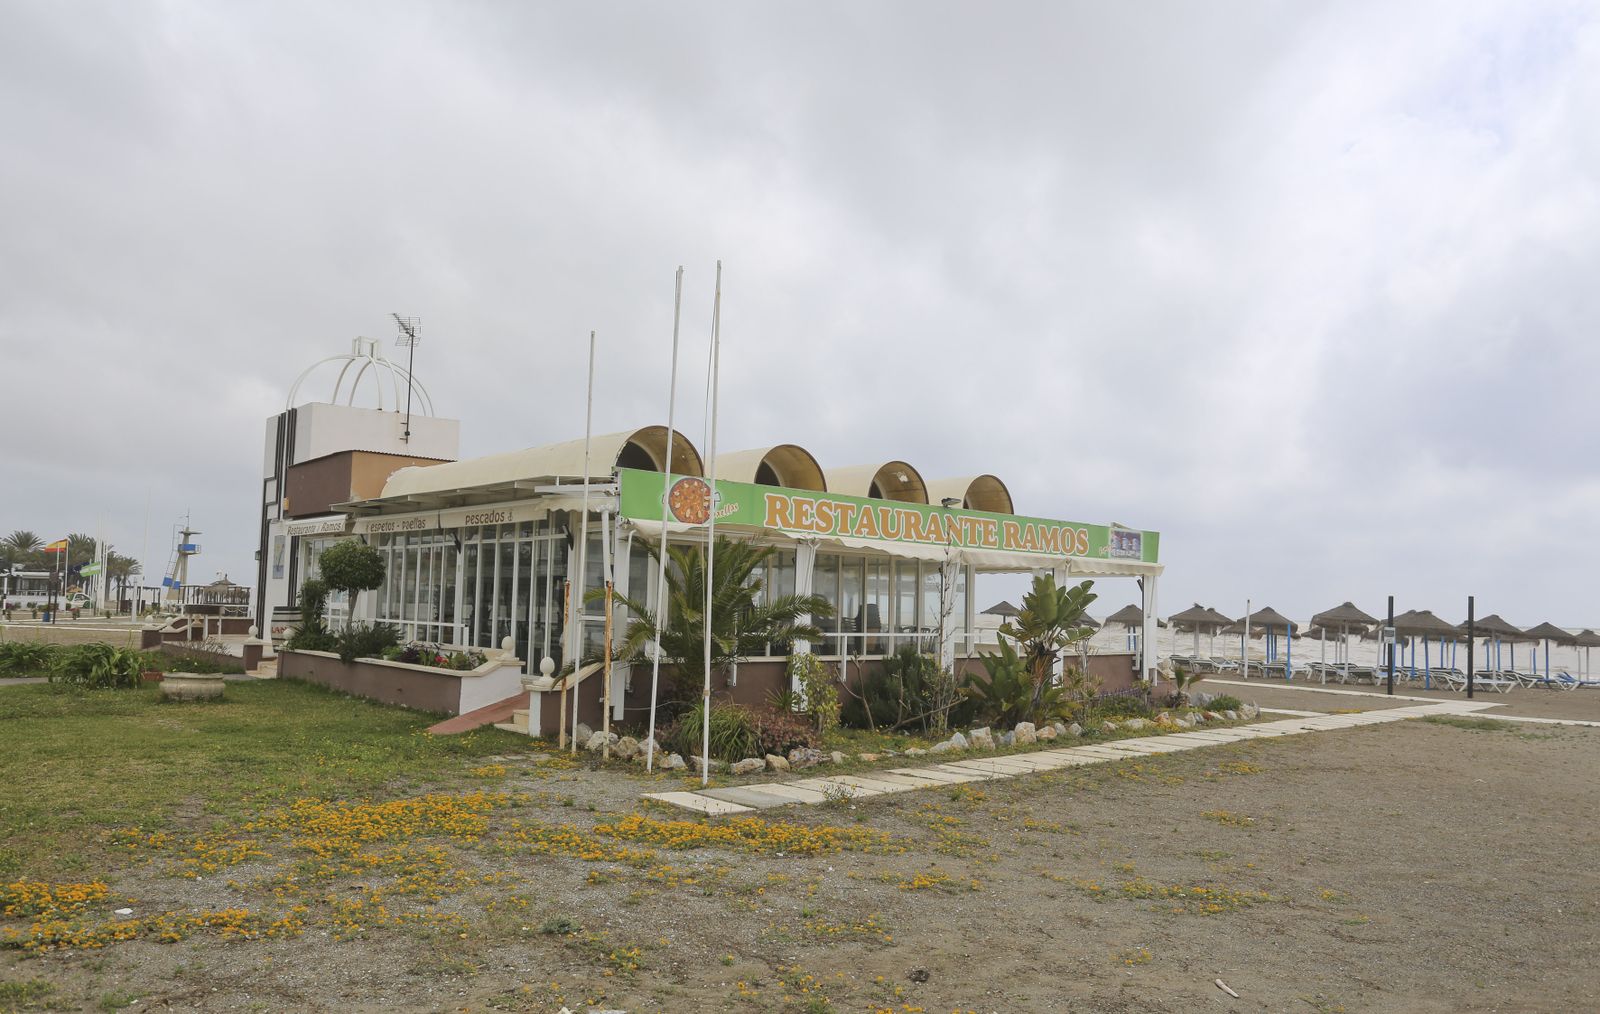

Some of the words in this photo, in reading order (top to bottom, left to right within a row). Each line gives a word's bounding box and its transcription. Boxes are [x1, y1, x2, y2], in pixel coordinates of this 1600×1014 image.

[465, 509, 505, 525] pescados
[764, 493, 998, 547] RESTAURANTE
[1002, 520, 1089, 556] RAMOS
